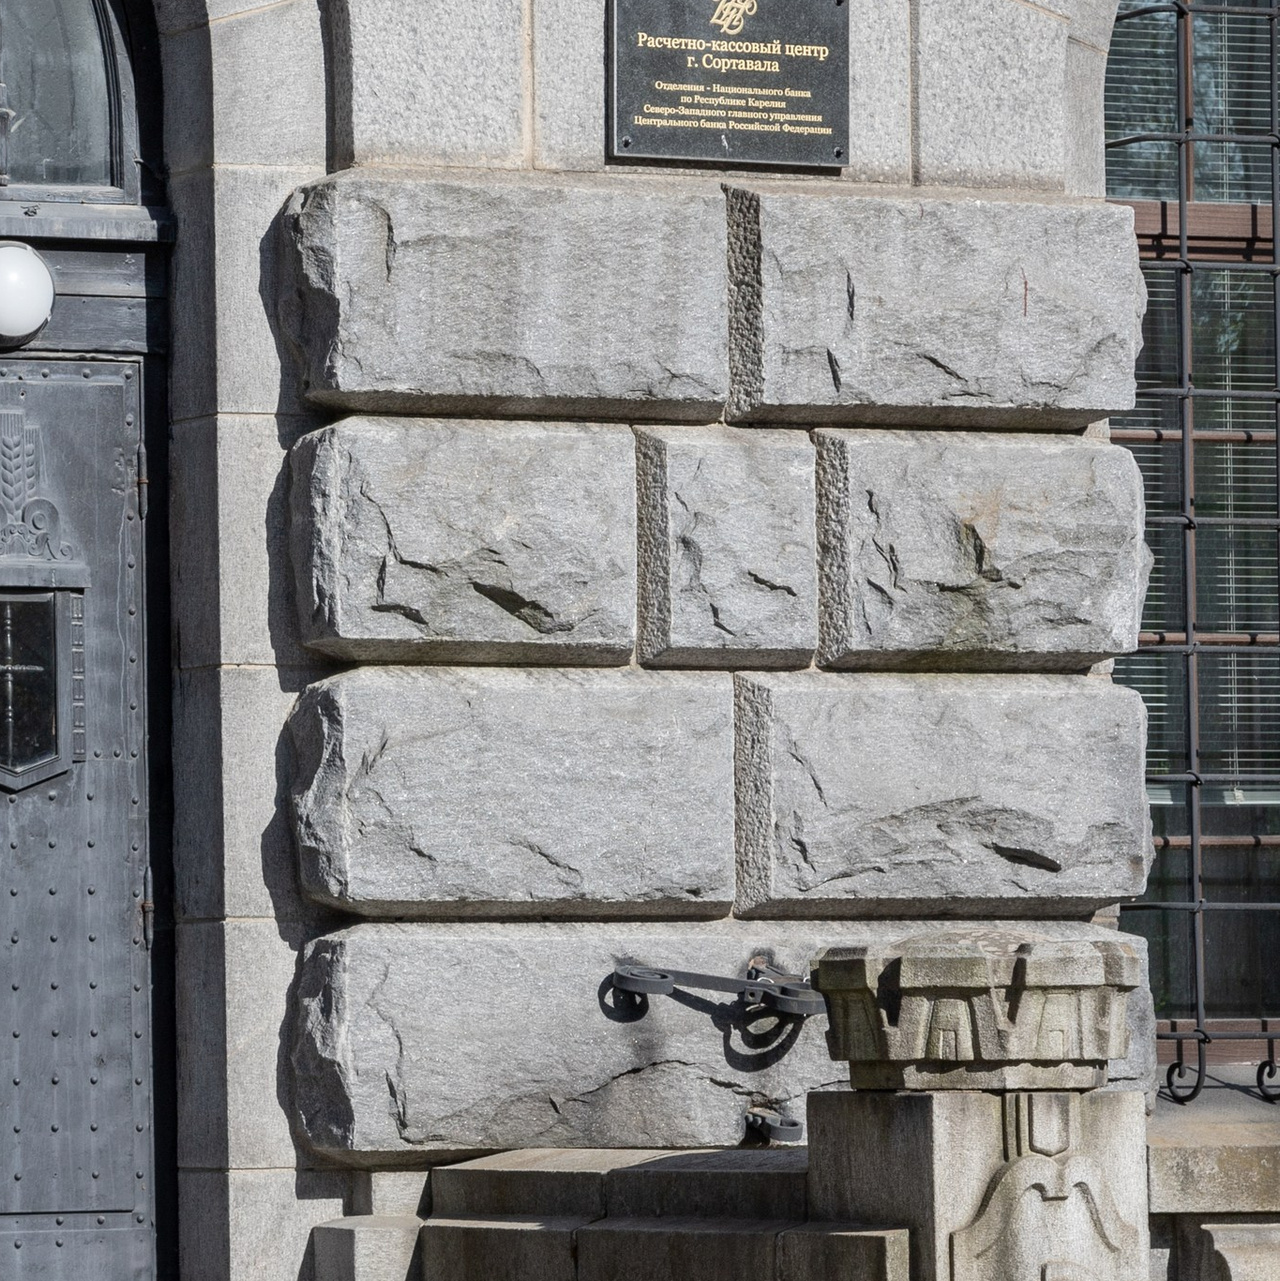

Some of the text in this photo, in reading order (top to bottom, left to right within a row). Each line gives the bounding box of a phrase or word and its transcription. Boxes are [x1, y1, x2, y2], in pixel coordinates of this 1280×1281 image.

[637, 32, 829, 61] Расчетно-кассовый центр
[686, 53, 780, 73] г. Сортавала
[654, 80, 705, 92] Отделения
[712, 83, 784, 96] Национального
[784, 87, 812, 98] банка
[680, 94, 786, 109] по Республике Карелия
[643, 104, 823, 123] Северо-Западного главного управления
[634, 116, 832, 135] Центрального банка Российской Федерации
